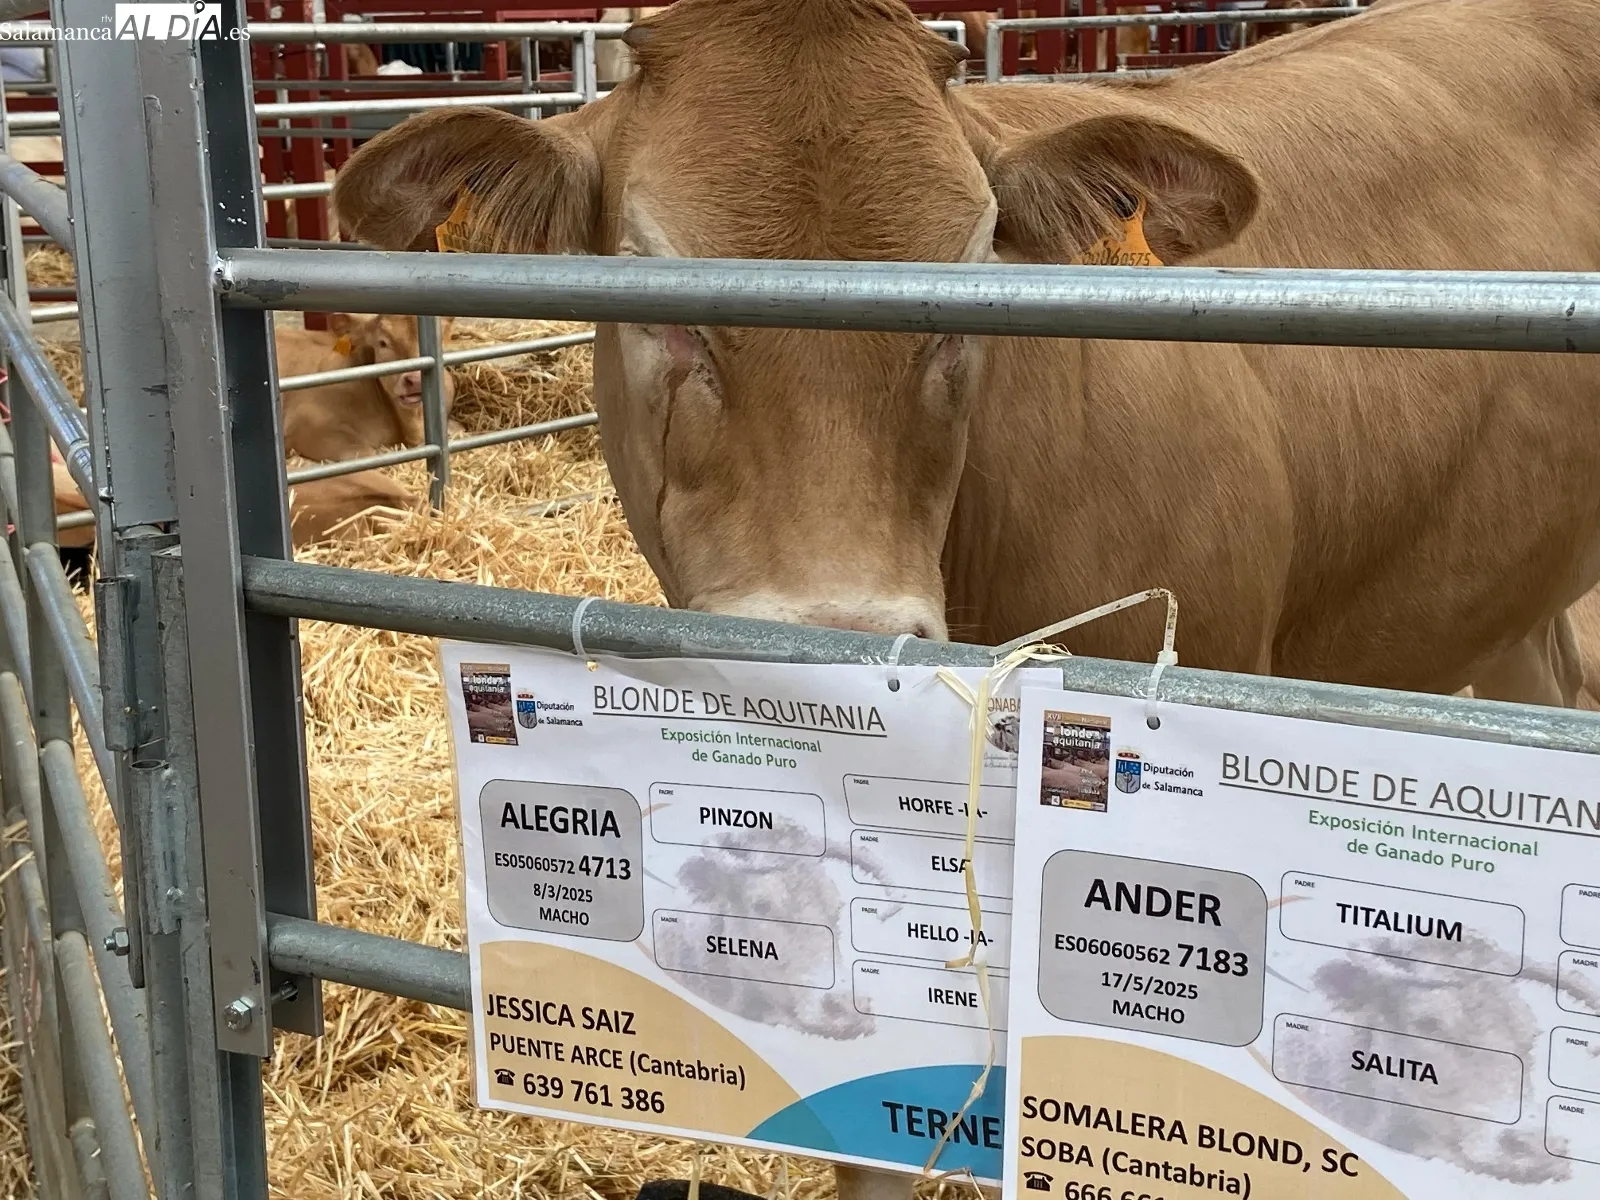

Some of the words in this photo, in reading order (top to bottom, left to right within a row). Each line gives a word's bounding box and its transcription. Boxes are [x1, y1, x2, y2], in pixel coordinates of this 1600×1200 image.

[536, 700, 574, 712] Diputación
[594, 686, 696, 714] BLONDE
[702, 692, 736, 716] DE
[743, 696, 886, 732] AQUITANIA
[546, 716, 584, 726] Salamanca
[661, 728, 732, 745] Exposición
[736, 732, 822, 752] Internacional
[692, 749, 708, 762] de
[712, 751, 762, 766] Ganado
[766, 756, 797, 769] Puro
[1143, 762, 1194, 778] Diputación
[1142, 782, 1151, 790] de
[1154, 782, 1204, 797] Salamanca
[1222, 752, 1359, 798] BLONDE
[1372, 773, 1418, 806] DE
[1429, 782, 1600, 831] AQUITAN
[700, 806, 773, 830] PINZON
[898, 796, 954, 816] HORFE
[500, 802, 621, 838] ALEGRIA
[860, 835, 879, 843] MADRE
[1308, 809, 1405, 838] Exposición
[1411, 824, 1539, 856] Internacional
[494, 852, 576, 875] ES05060572
[578, 855, 632, 880] 4713
[1346, 839, 1368, 854] de
[1374, 842, 1444, 866] Ganado
[1450, 853, 1495, 874] Puro
[533, 883, 593, 903] 8/3/2025
[1294, 879, 1316, 888] PADRE
[1084, 878, 1222, 926] ANDER
[539, 906, 590, 926] MACHO
[1336, 902, 1463, 942] TITALIUM
[907, 922, 959, 942] HELLO
[963, 930, 994, 946] -IA-
[706, 935, 779, 960] SELENA
[1054, 933, 1170, 965] ES06060562
[1177, 943, 1249, 978] 7183
[1572, 958, 1598, 968] MADRE
[928, 987, 978, 1008] IRENE
[1101, 971, 1198, 1000] 17/5/2025
[486, 993, 576, 1028] JESSICA
[582, 1006, 636, 1036] SAIZ
[1112, 999, 1185, 1024] MACHO
[1285, 1021, 1310, 1032] MADRE
[1566, 1037, 1589, 1048] PADRE
[490, 1032, 565, 1062] PUENTE
[570, 1044, 624, 1070] ARCE
[629, 1050, 746, 1090] (Cantabria)
[1350, 1050, 1438, 1086] SALITA
[523, 1072, 564, 1099] 639
[570, 1079, 613, 1108] 761
[620, 1086, 665, 1114] 386
[1558, 1104, 1585, 1114] MADRE
[1022, 1095, 1188, 1145] SOMALERA
[1198, 1124, 1311, 1172] BLOND,
[1322, 1148, 1359, 1178] SC
[1020, 1136, 1094, 1168] SOBA
[1102, 1148, 1252, 1200] (Cantabria)
